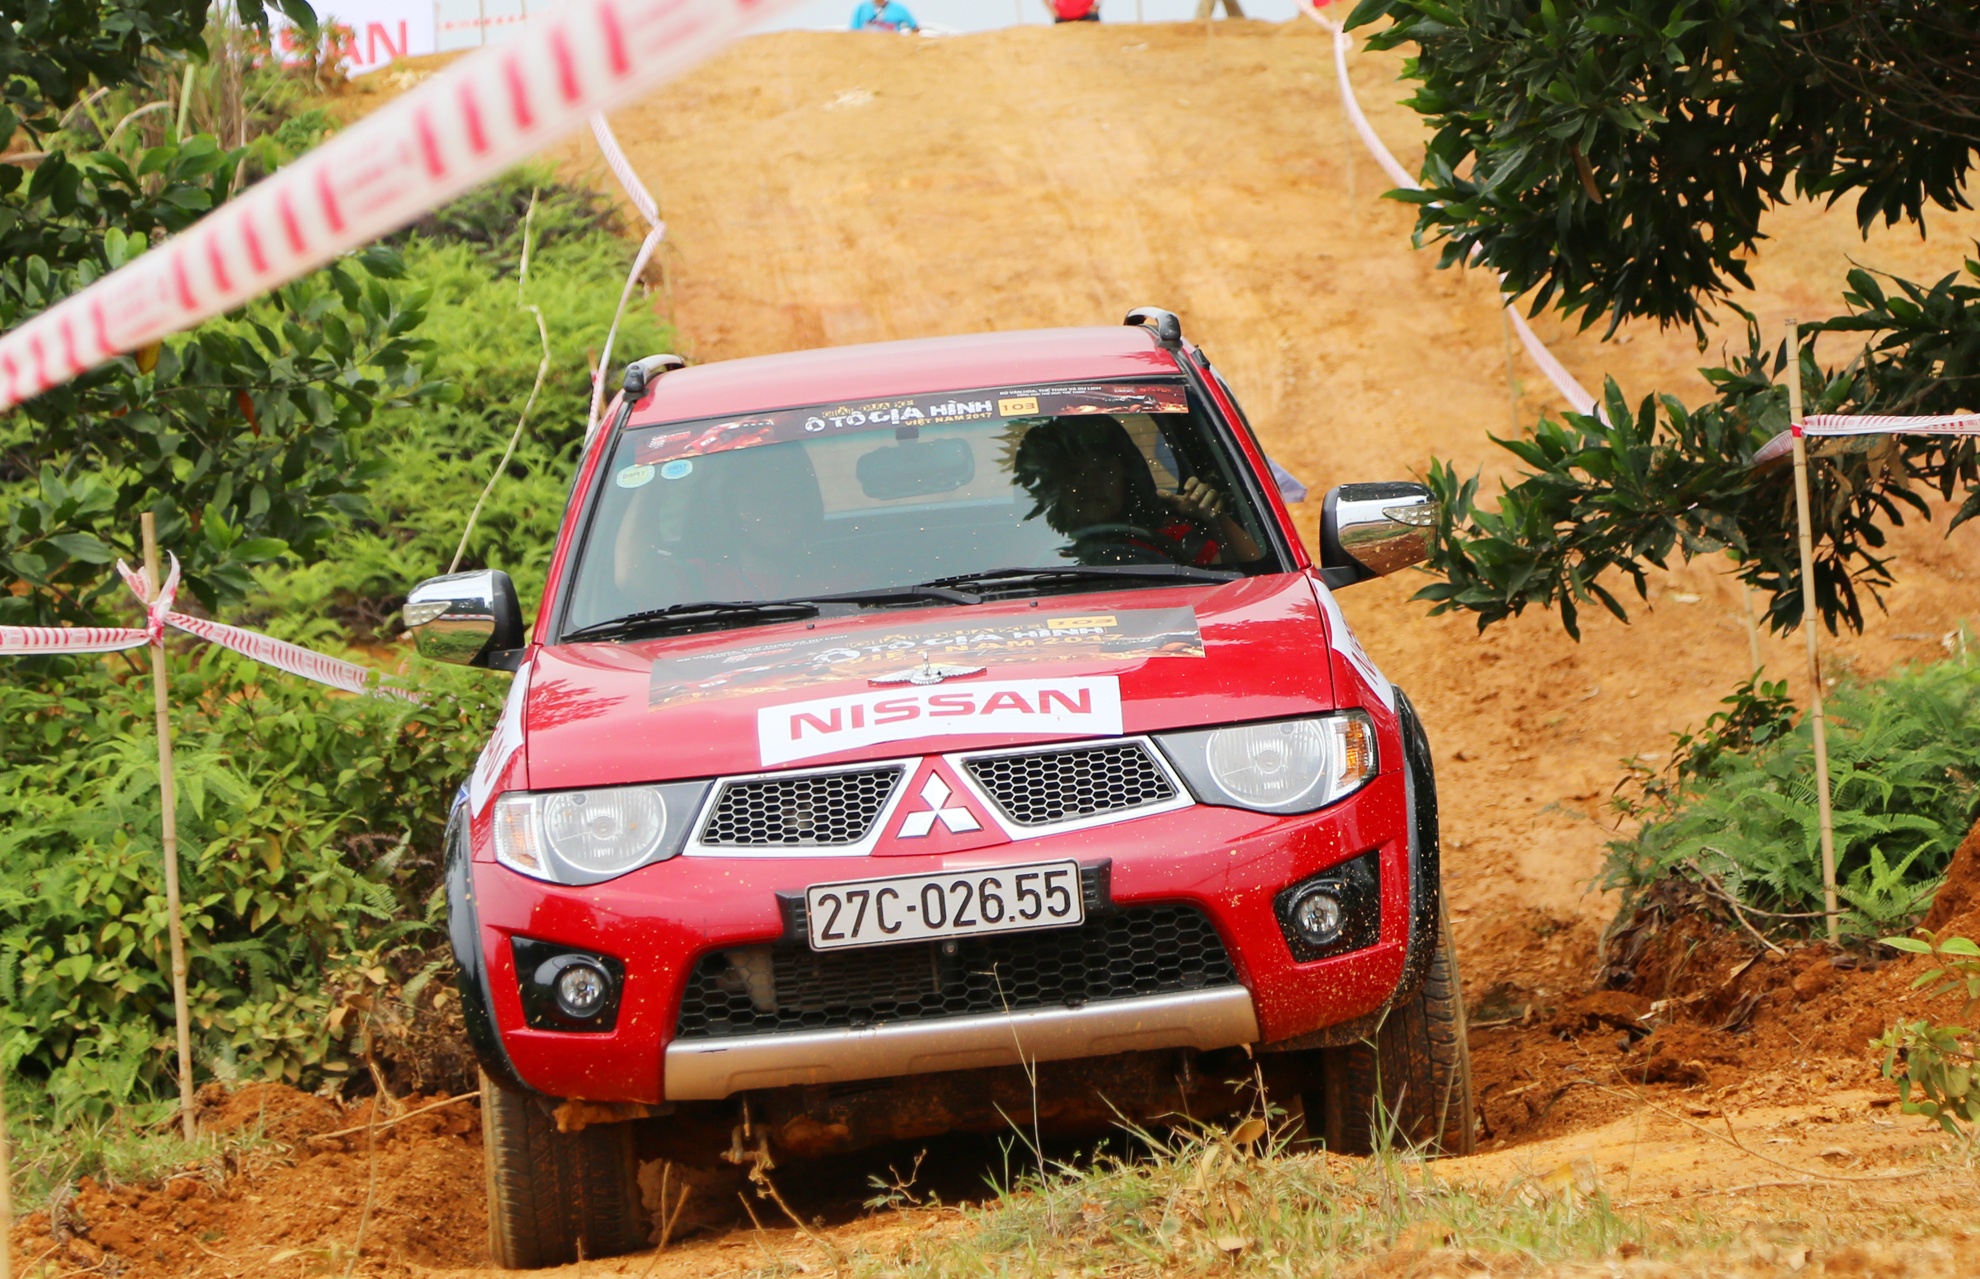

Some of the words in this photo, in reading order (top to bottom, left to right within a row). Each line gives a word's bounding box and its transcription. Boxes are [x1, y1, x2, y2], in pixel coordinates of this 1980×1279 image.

[1002, 402, 1036, 411] 103
[789, 687, 1092, 741] NISSAN
[817, 869, 1072, 941] 27C-026.55
